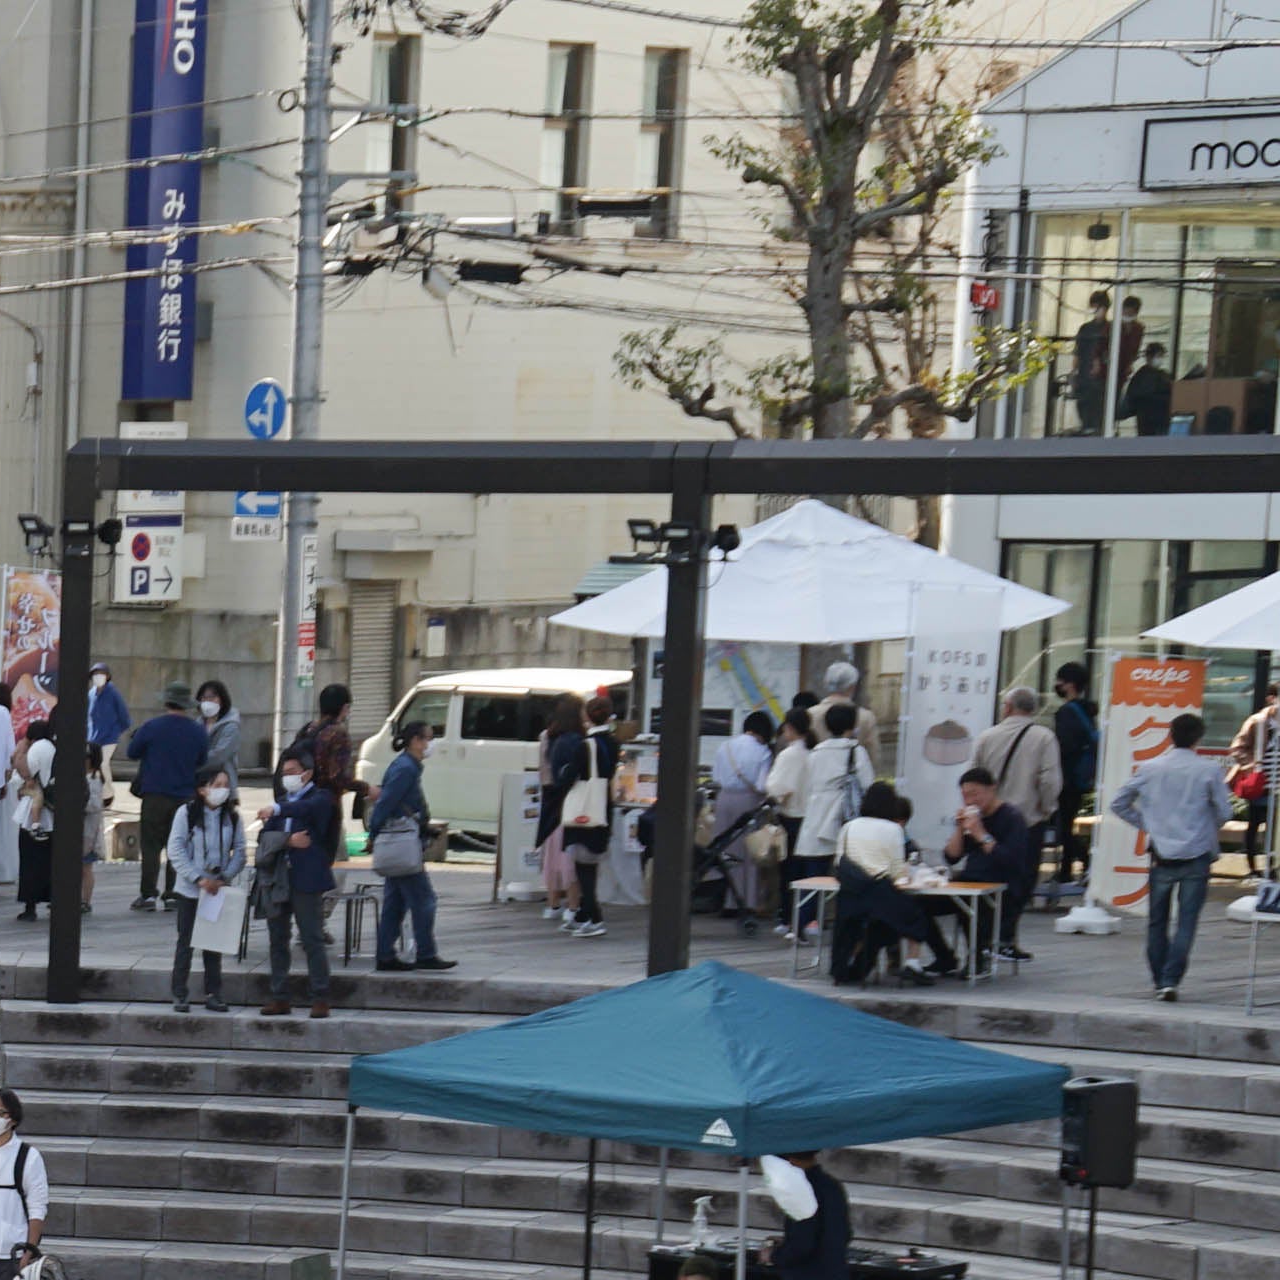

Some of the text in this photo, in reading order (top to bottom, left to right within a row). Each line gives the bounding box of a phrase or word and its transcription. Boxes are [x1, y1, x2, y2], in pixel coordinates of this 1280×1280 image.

[156, 188, 186, 363] みずほ銀行
